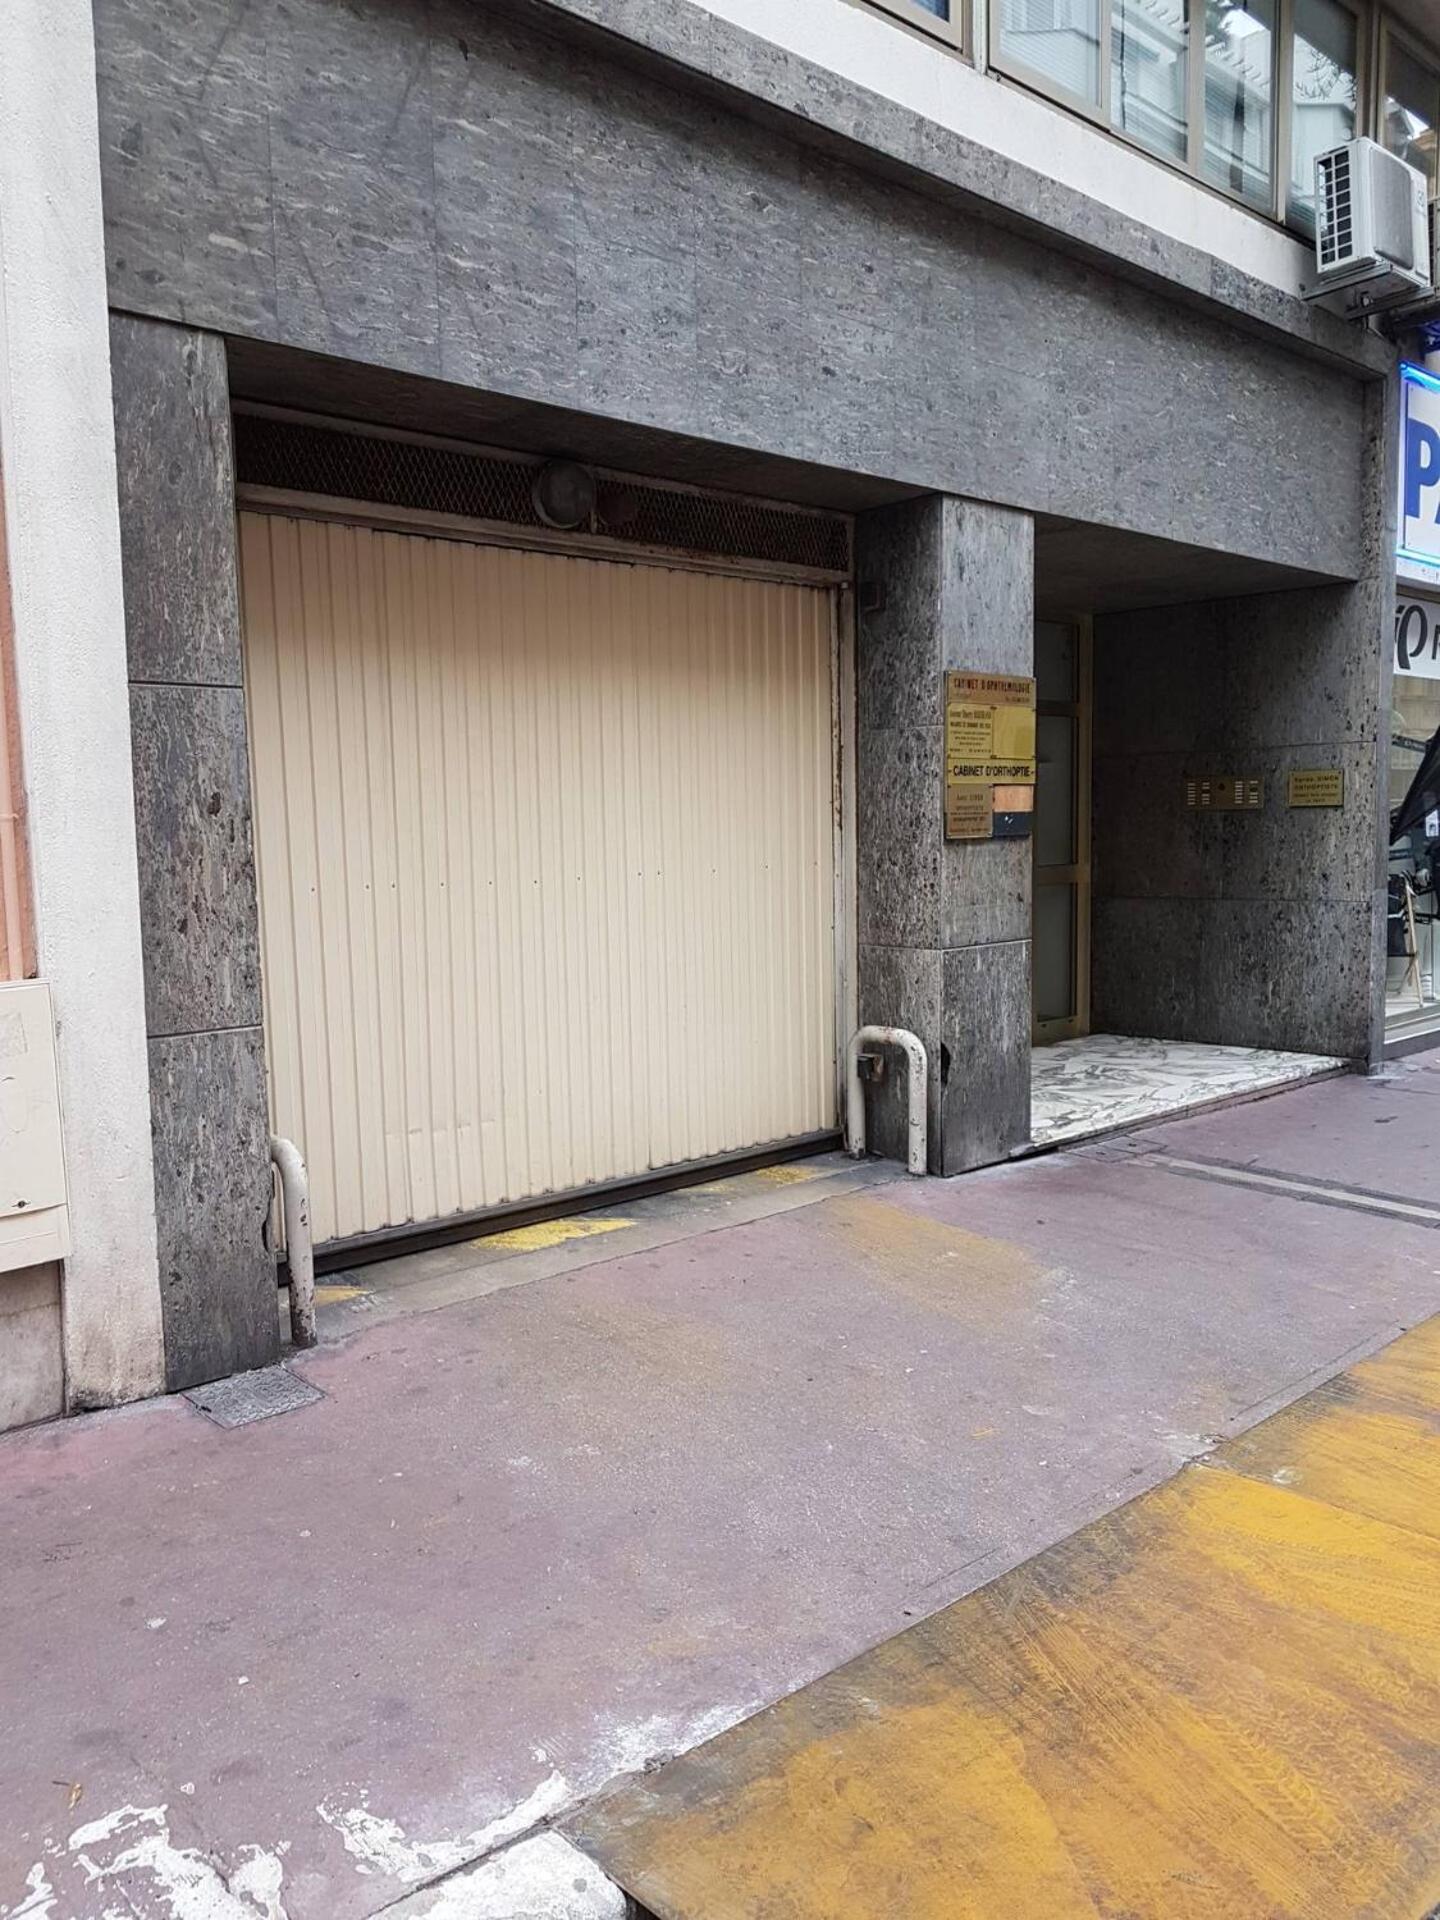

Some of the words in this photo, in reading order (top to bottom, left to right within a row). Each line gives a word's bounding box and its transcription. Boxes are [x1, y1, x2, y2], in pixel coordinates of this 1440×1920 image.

[1403, 416, 1440, 524] P
[953, 764, 984, 777] CABINET
[986, 765, 1030, 777] D'ORTHOPTIE
